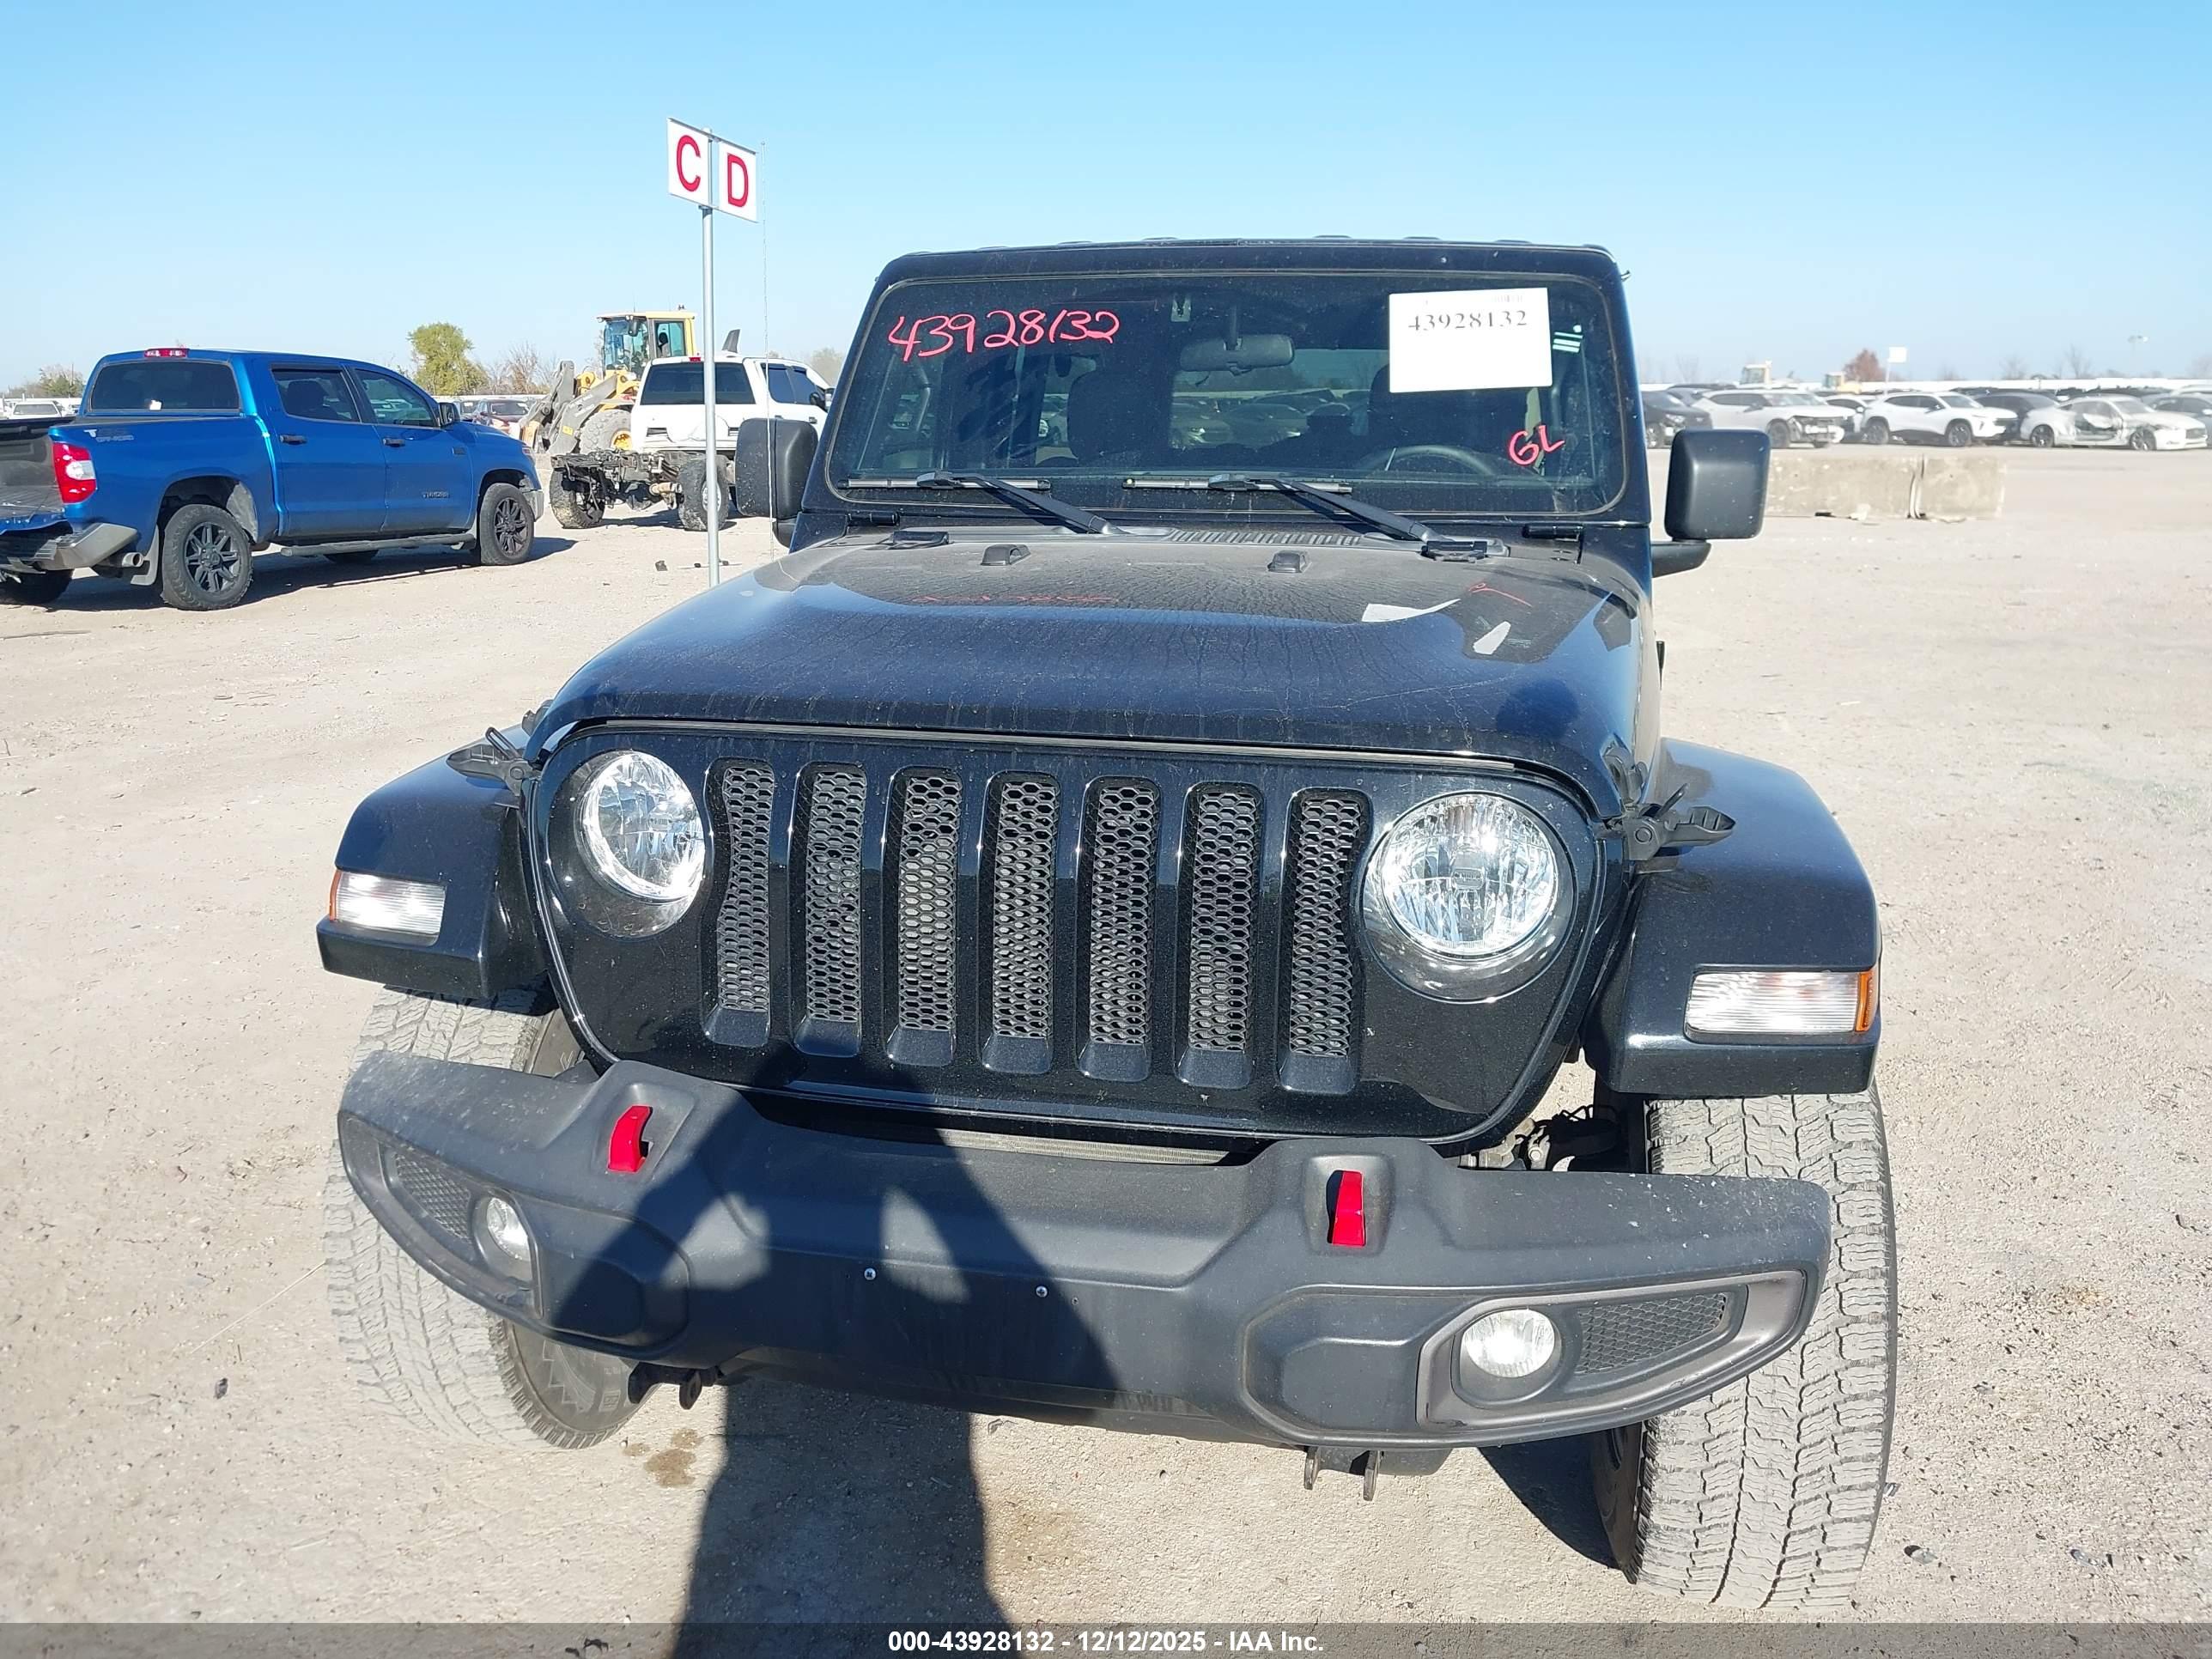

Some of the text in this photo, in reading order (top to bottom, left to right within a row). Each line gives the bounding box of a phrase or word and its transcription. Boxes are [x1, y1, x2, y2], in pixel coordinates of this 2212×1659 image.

[676, 135, 702, 192] C
[726, 153, 749, 208] D
[888, 309, 1120, 362] 43928132
[1408, 309, 1528, 331] 43928132
[1509, 425, 1565, 465] GL
